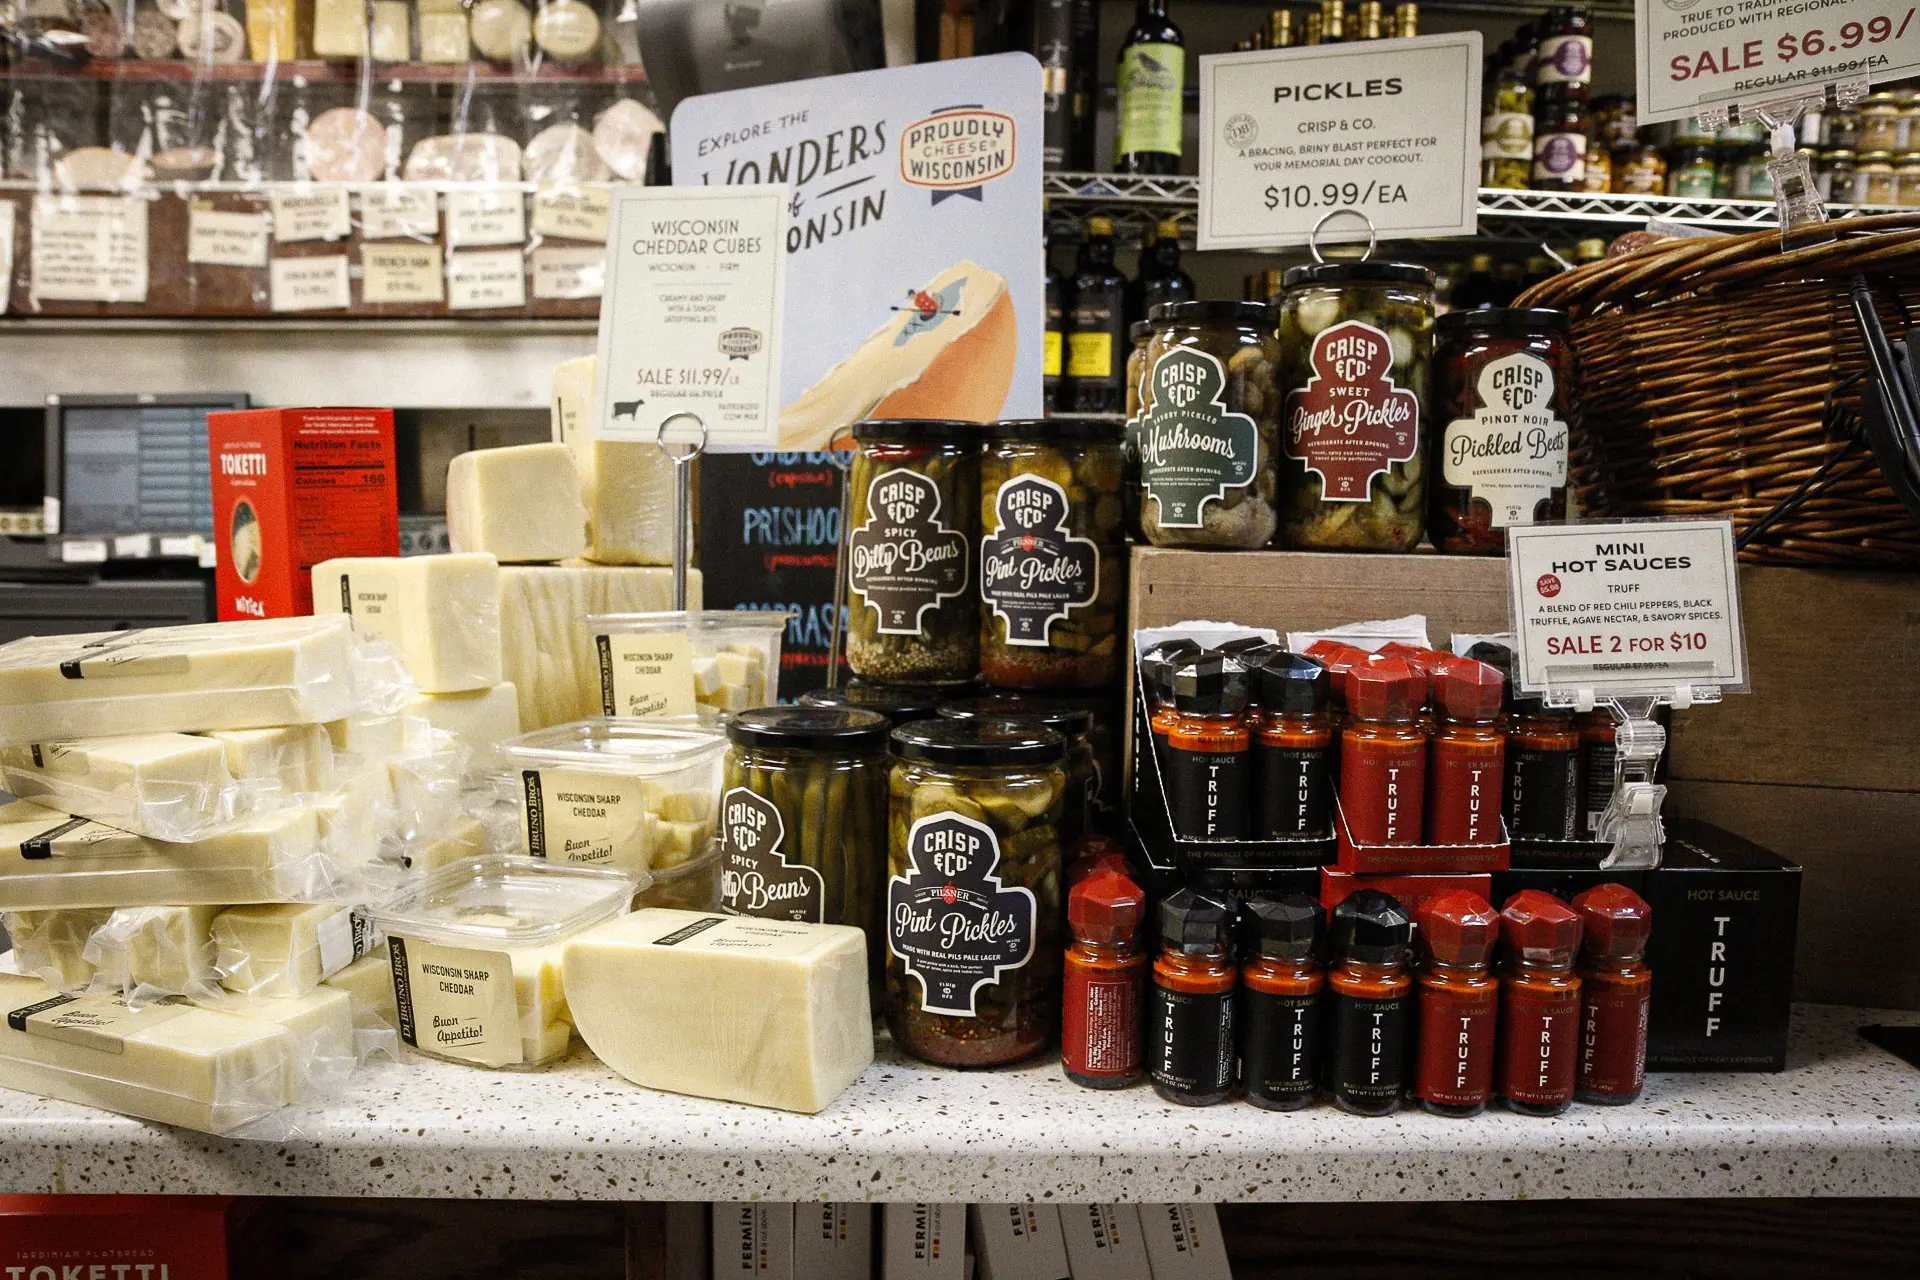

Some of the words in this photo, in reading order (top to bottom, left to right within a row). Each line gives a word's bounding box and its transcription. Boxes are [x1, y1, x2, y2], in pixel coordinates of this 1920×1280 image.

[1663, 18, 1736, 42] PRODUCED
[1739, 10, 1772, 26] WITH
[1680, 9, 1713, 25] TRUE
[1716, 5, 1734, 17] TO
[1670, 39, 1764, 82] SALE
[1274, 78, 1403, 104] PICKLES
[1734, 70, 1806, 92] REGULAR
[698, 120, 772, 157] EXPLORE
[779, 110, 810, 129] THE
[910, 119, 1005, 149] PROUDLY
[1297, 120, 1336, 134] CRISP
[1339, 119, 1348, 131] &
[1352, 118, 1376, 131] CO.
[1238, 149, 1246, 158] A
[1248, 146, 1297, 158] BRACING,
[1299, 144, 1330, 154] BRINY
[1333, 142, 1364, 153] BLAST
[1367, 139, 1412, 150] PERFECT
[1415, 137, 1437, 148] FOR
[910, 149, 1005, 180] WISCONSIN
[1254, 161, 1282, 172] YOUR
[1284, 158, 1341, 170] MEMORIAL
[1343, 156, 1365, 167] DAY
[1367, 152, 1423, 165] COOKOUT.
[1264, 180, 1408, 211] $10.99/EA
[651, 219, 740, 237] WISCONSIN
[786, 189, 887, 254] ONSIN
[632, 239, 708, 256] CHEDDAR
[713, 237, 762, 254] CUBES
[1326, 336, 1378, 362] CRISP
[636, 368, 673, 385] SALE
[1161, 361, 1207, 389] CRISP
[1493, 364, 1544, 390] CRISP
[1329, 386, 1370, 398] SWEET
[1181, 410, 1217, 425] PICKLED
[1292, 404, 1344, 445] Ginger
[1343, 397, 1411, 436] Pickles
[1481, 415, 1519, 426] PINOT
[1523, 415, 1550, 427] NOIR
[1142, 423, 1236, 467] Mushrooms
[1450, 432, 1524, 467] Pickled
[1526, 428, 1567, 461] Beets
[220, 453, 267, 476] TOKETTI
[880, 482, 926, 505] CRISP
[1007, 488, 1053, 511] CRISP
[884, 527, 917, 539] SPICY
[854, 543, 899, 579] Dilly
[899, 539, 960, 573] Beans
[1595, 543, 1645, 556] MINI
[985, 556, 1018, 587] Pint
[1019, 557, 1082, 590] Pickles
[1552, 560, 1597, 574] HOT
[1604, 556, 1692, 572] SAUCES
[1539, 577, 1556, 586] SAVE
[1607, 584, 1640, 593] TRUFF
[1547, 604, 1576, 613] BLEND
[1578, 603, 1591, 612] OF
[1593, 603, 1611, 611] RED
[1613, 602, 1637, 610] CHILI
[1639, 601, 1681, 610] PEPPERS,
[1683, 599, 1713, 608] BLACK
[1530, 616, 1571, 626] TRUFFLE,
[1572, 616, 1601, 625] AGAVE
[1604, 614, 1641, 624] NECTAR,
[1642, 613, 1649, 622] &
[1651, 613, 1686, 622] SAVORY
[1688, 611, 1723, 621] SPICES.
[1547, 635, 1602, 656] SALE
[1609, 635, 1622, 653] 2
[1629, 637, 1664, 652] FOR
[1670, 631, 1708, 653] $10
[635, 665, 662, 675] CHEDDAR
[1593, 663, 1630, 672] REGULAR
[557, 792, 595, 804] WISCONSIN
[596, 793, 622, 805] SHARP
[1208, 766, 1219, 836] TRUFF
[1298, 761, 1309, 831] TRUFF
[1387, 768, 1399, 840] TRUFF
[1469, 770, 1482, 841] TRUFF
[1512, 761, 1524, 830] TRUFF
[573, 806, 607, 818] CHEDDAR
[728, 803, 767, 832] CRISP
[530, 809, 540, 850] BRUNO
[564, 839, 590, 852] Buon
[924, 829, 980, 856] CRISP
[731, 855, 758, 870] SPICY
[742, 871, 811, 910] Beans
[931, 887, 969, 901] PILSNER
[1687, 890, 1714, 901] HOT
[1718, 890, 1760, 901] SAUCE
[895, 903, 937, 938] Pint
[939, 910, 1018, 949] Pickles
[902, 943, 916, 953] MADE
[916, 947, 931, 957] WITH
[931, 950, 947, 959] REAL
[947, 952, 962, 961] PILS
[422, 963, 463, 979] WISCONSIN
[463, 969, 489, 982] SHARP
[1706, 916, 1731, 1037] TRUFF
[439, 981, 474, 996] CHEDDAR
[397, 979, 409, 1023] BRUNO
[1375, 1002, 1400, 1011] SAUCE
[403, 1024, 411, 1038] DI
[432, 1015, 459, 1029] Buon
[437, 1025, 483, 1044] Appetito!
[1164, 1002, 1175, 1072] TRUFF
[1292, 1009, 1304, 1080] TRUFF
[1583, 1005, 1599, 1074] TRUFF
[1370, 1013, 1383, 1084] TRUFF
[1456, 1017, 1471, 1088] TRUFF
[1539, 1016, 1553, 1087] TRUFF
[86, 1249, 155, 1258] FLATBREAD
[5, 1264, 169, 1280] TOKETTI
